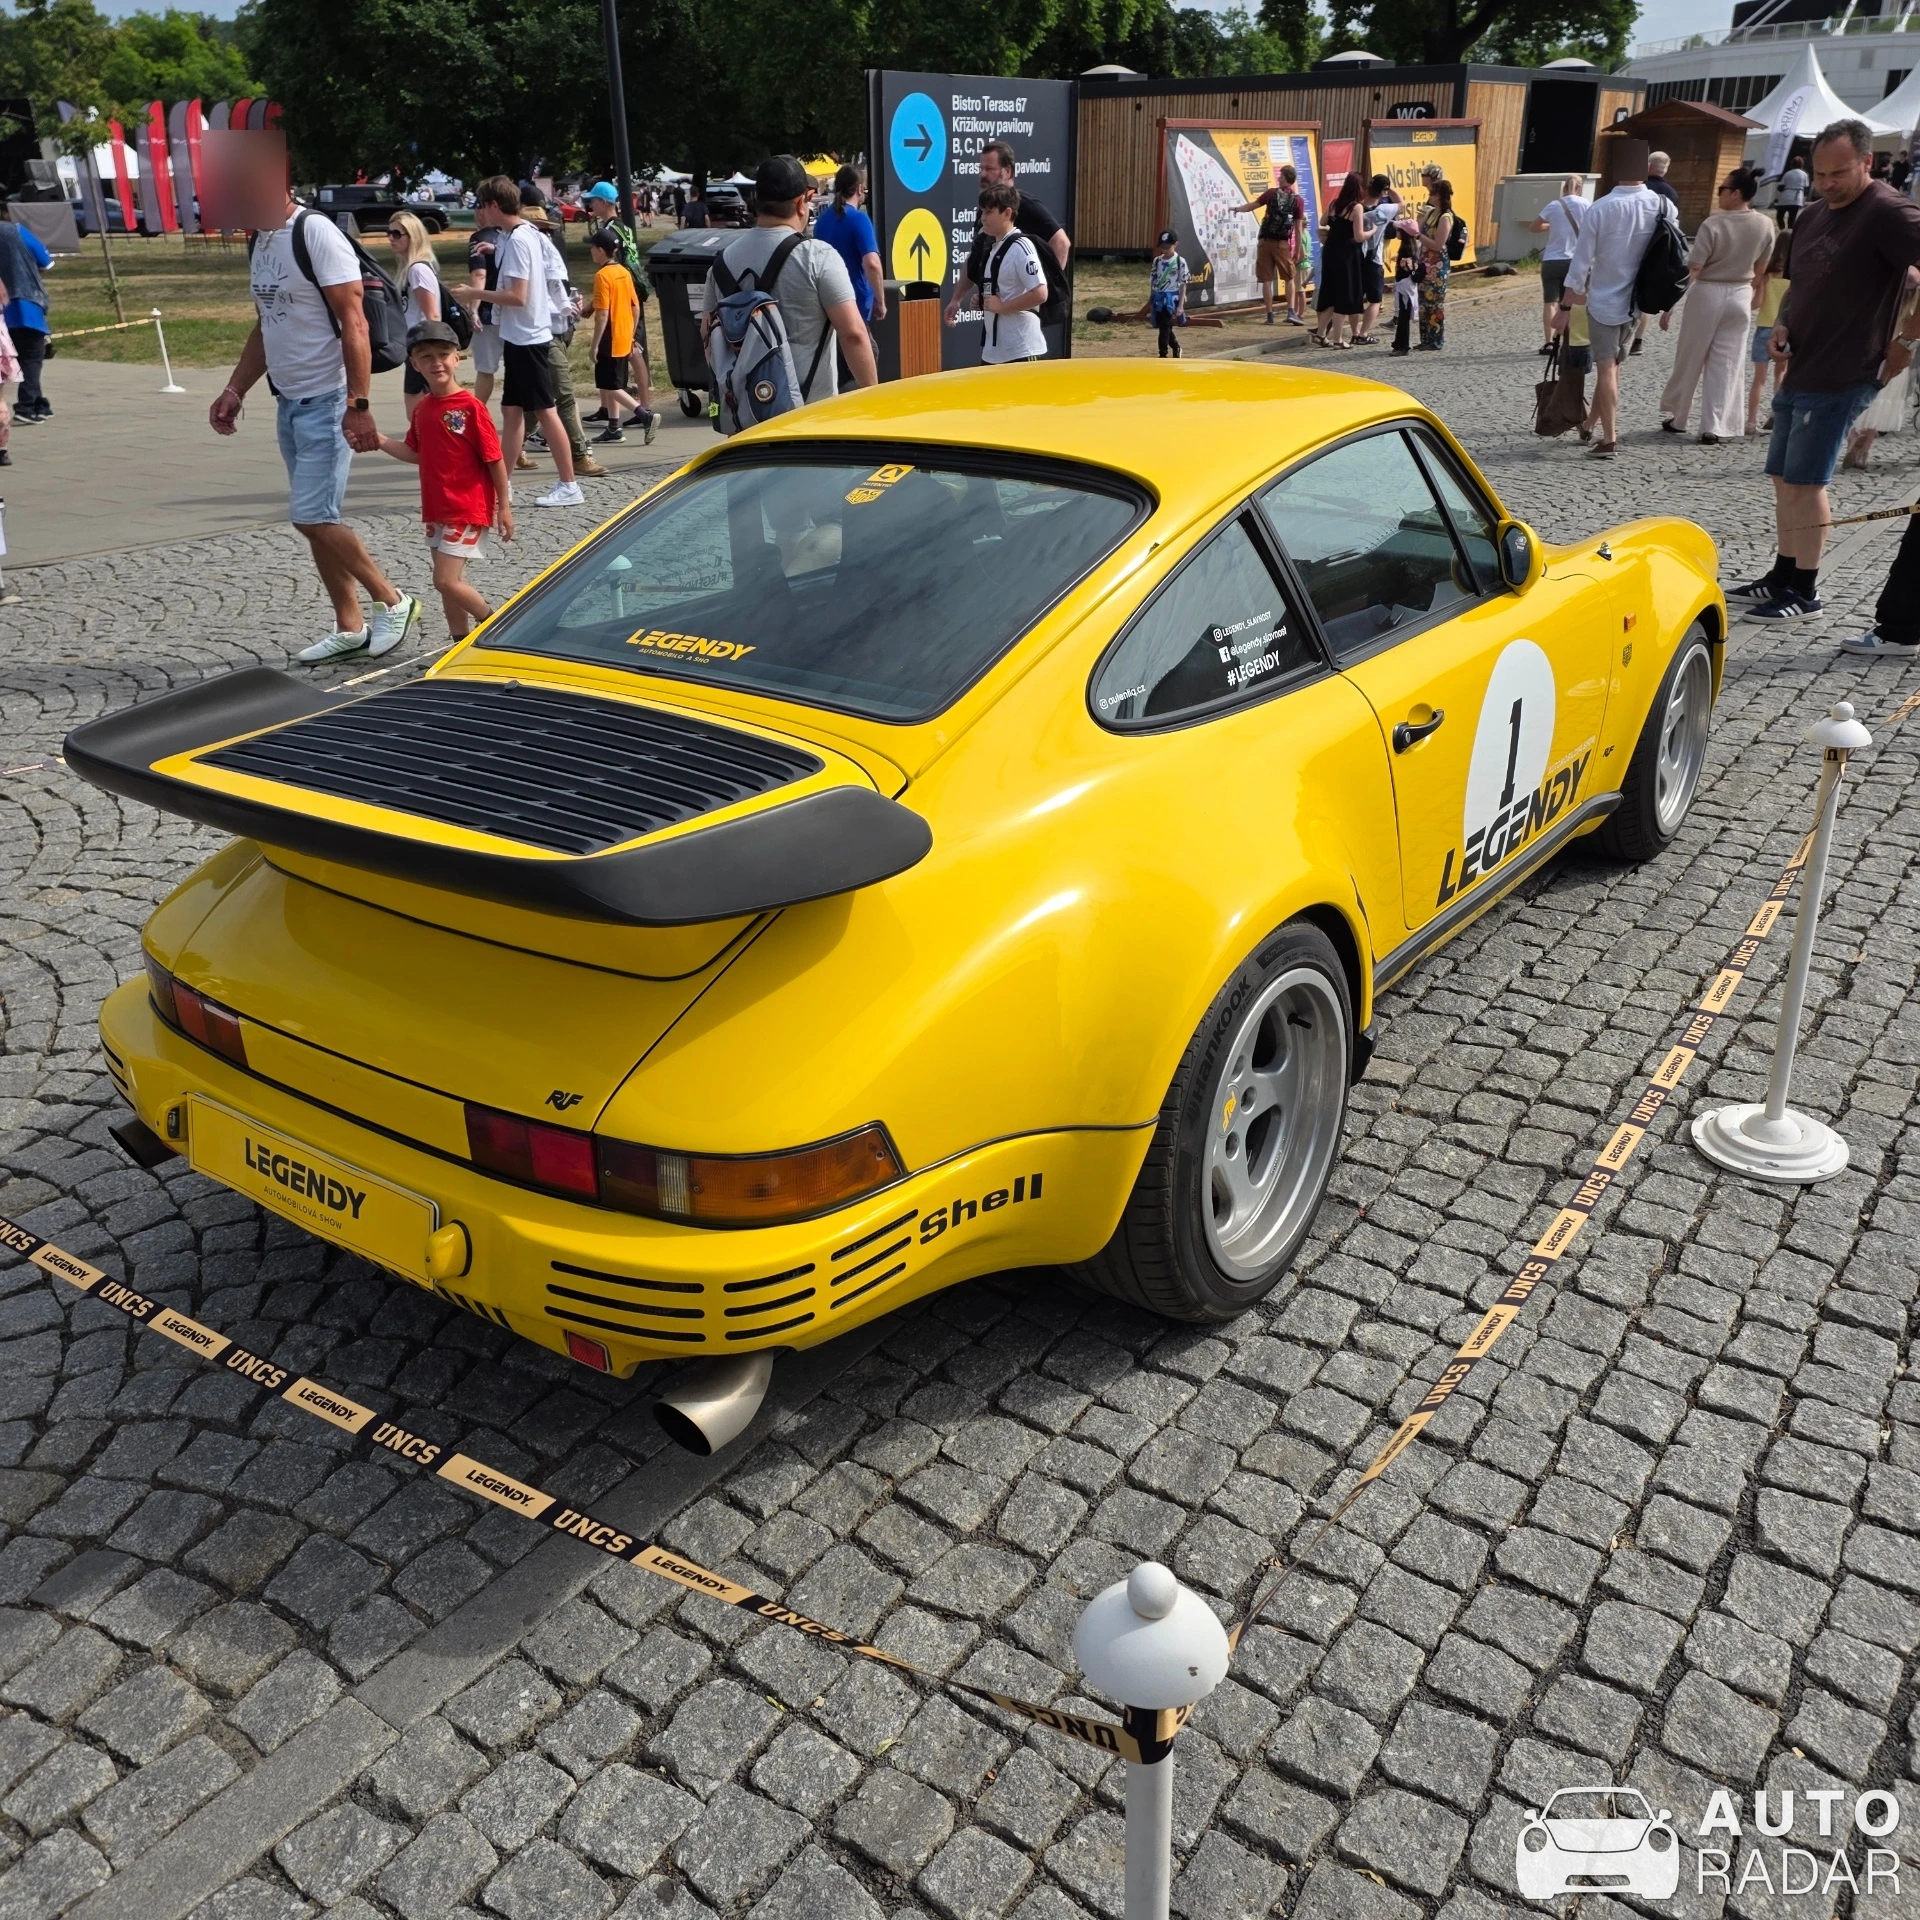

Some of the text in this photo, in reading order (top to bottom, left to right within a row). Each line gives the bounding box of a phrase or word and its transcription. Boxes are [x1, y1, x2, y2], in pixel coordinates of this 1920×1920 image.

[952, 95, 1028, 112] Bistro Terasa 67
[1396, 107, 1427, 119] WC
[952, 116, 1034, 137] Křižíkovy pavilony
[1412, 131, 1438, 143] LEGENDY
[952, 137, 962, 156] B,
[964, 137, 975, 156] C,
[952, 157, 1051, 177] Teras pavilonů
[1244, 171, 1269, 180] LEGENDY
[1386, 164, 1404, 189] Na
[952, 207, 977, 223] Letní
[952, 227, 975, 243] Stud
[626, 629, 756, 661] LEGENDY
[1227, 650, 1280, 686] #LEGENDY
[1498, 697, 1522, 811] 1
[1436, 749, 1592, 908] LEGENDY
[545, 1090, 584, 1111] RUF
[1421, 1363, 1470, 1406] UNCS
[1504, 1261, 1547, 1299] UNCS
[1573, 1171, 1611, 1206] UNCS
[1631, 1089, 1665, 1122] UNCS
[1682, 1014, 1714, 1044] UNCS
[1730, 939, 1760, 967] UNCS
[1771, 870, 1798, 897] UNCS
[245, 1137, 367, 1219] LEGENDY
[264, 1185, 343, 1230] AUTOMOBILOVÁ SHOW
[920, 1173, 1043, 1245] Shell
[99, 1281, 154, 1316] UNCS
[226, 1349, 287, 1388] UNCS
[372, 1422, 440, 1464] UNCS
[553, 1508, 633, 1552] UNCS
[757, 1602, 850, 1642] UNCS
[1010, 1700, 1120, 1752] UNCS
